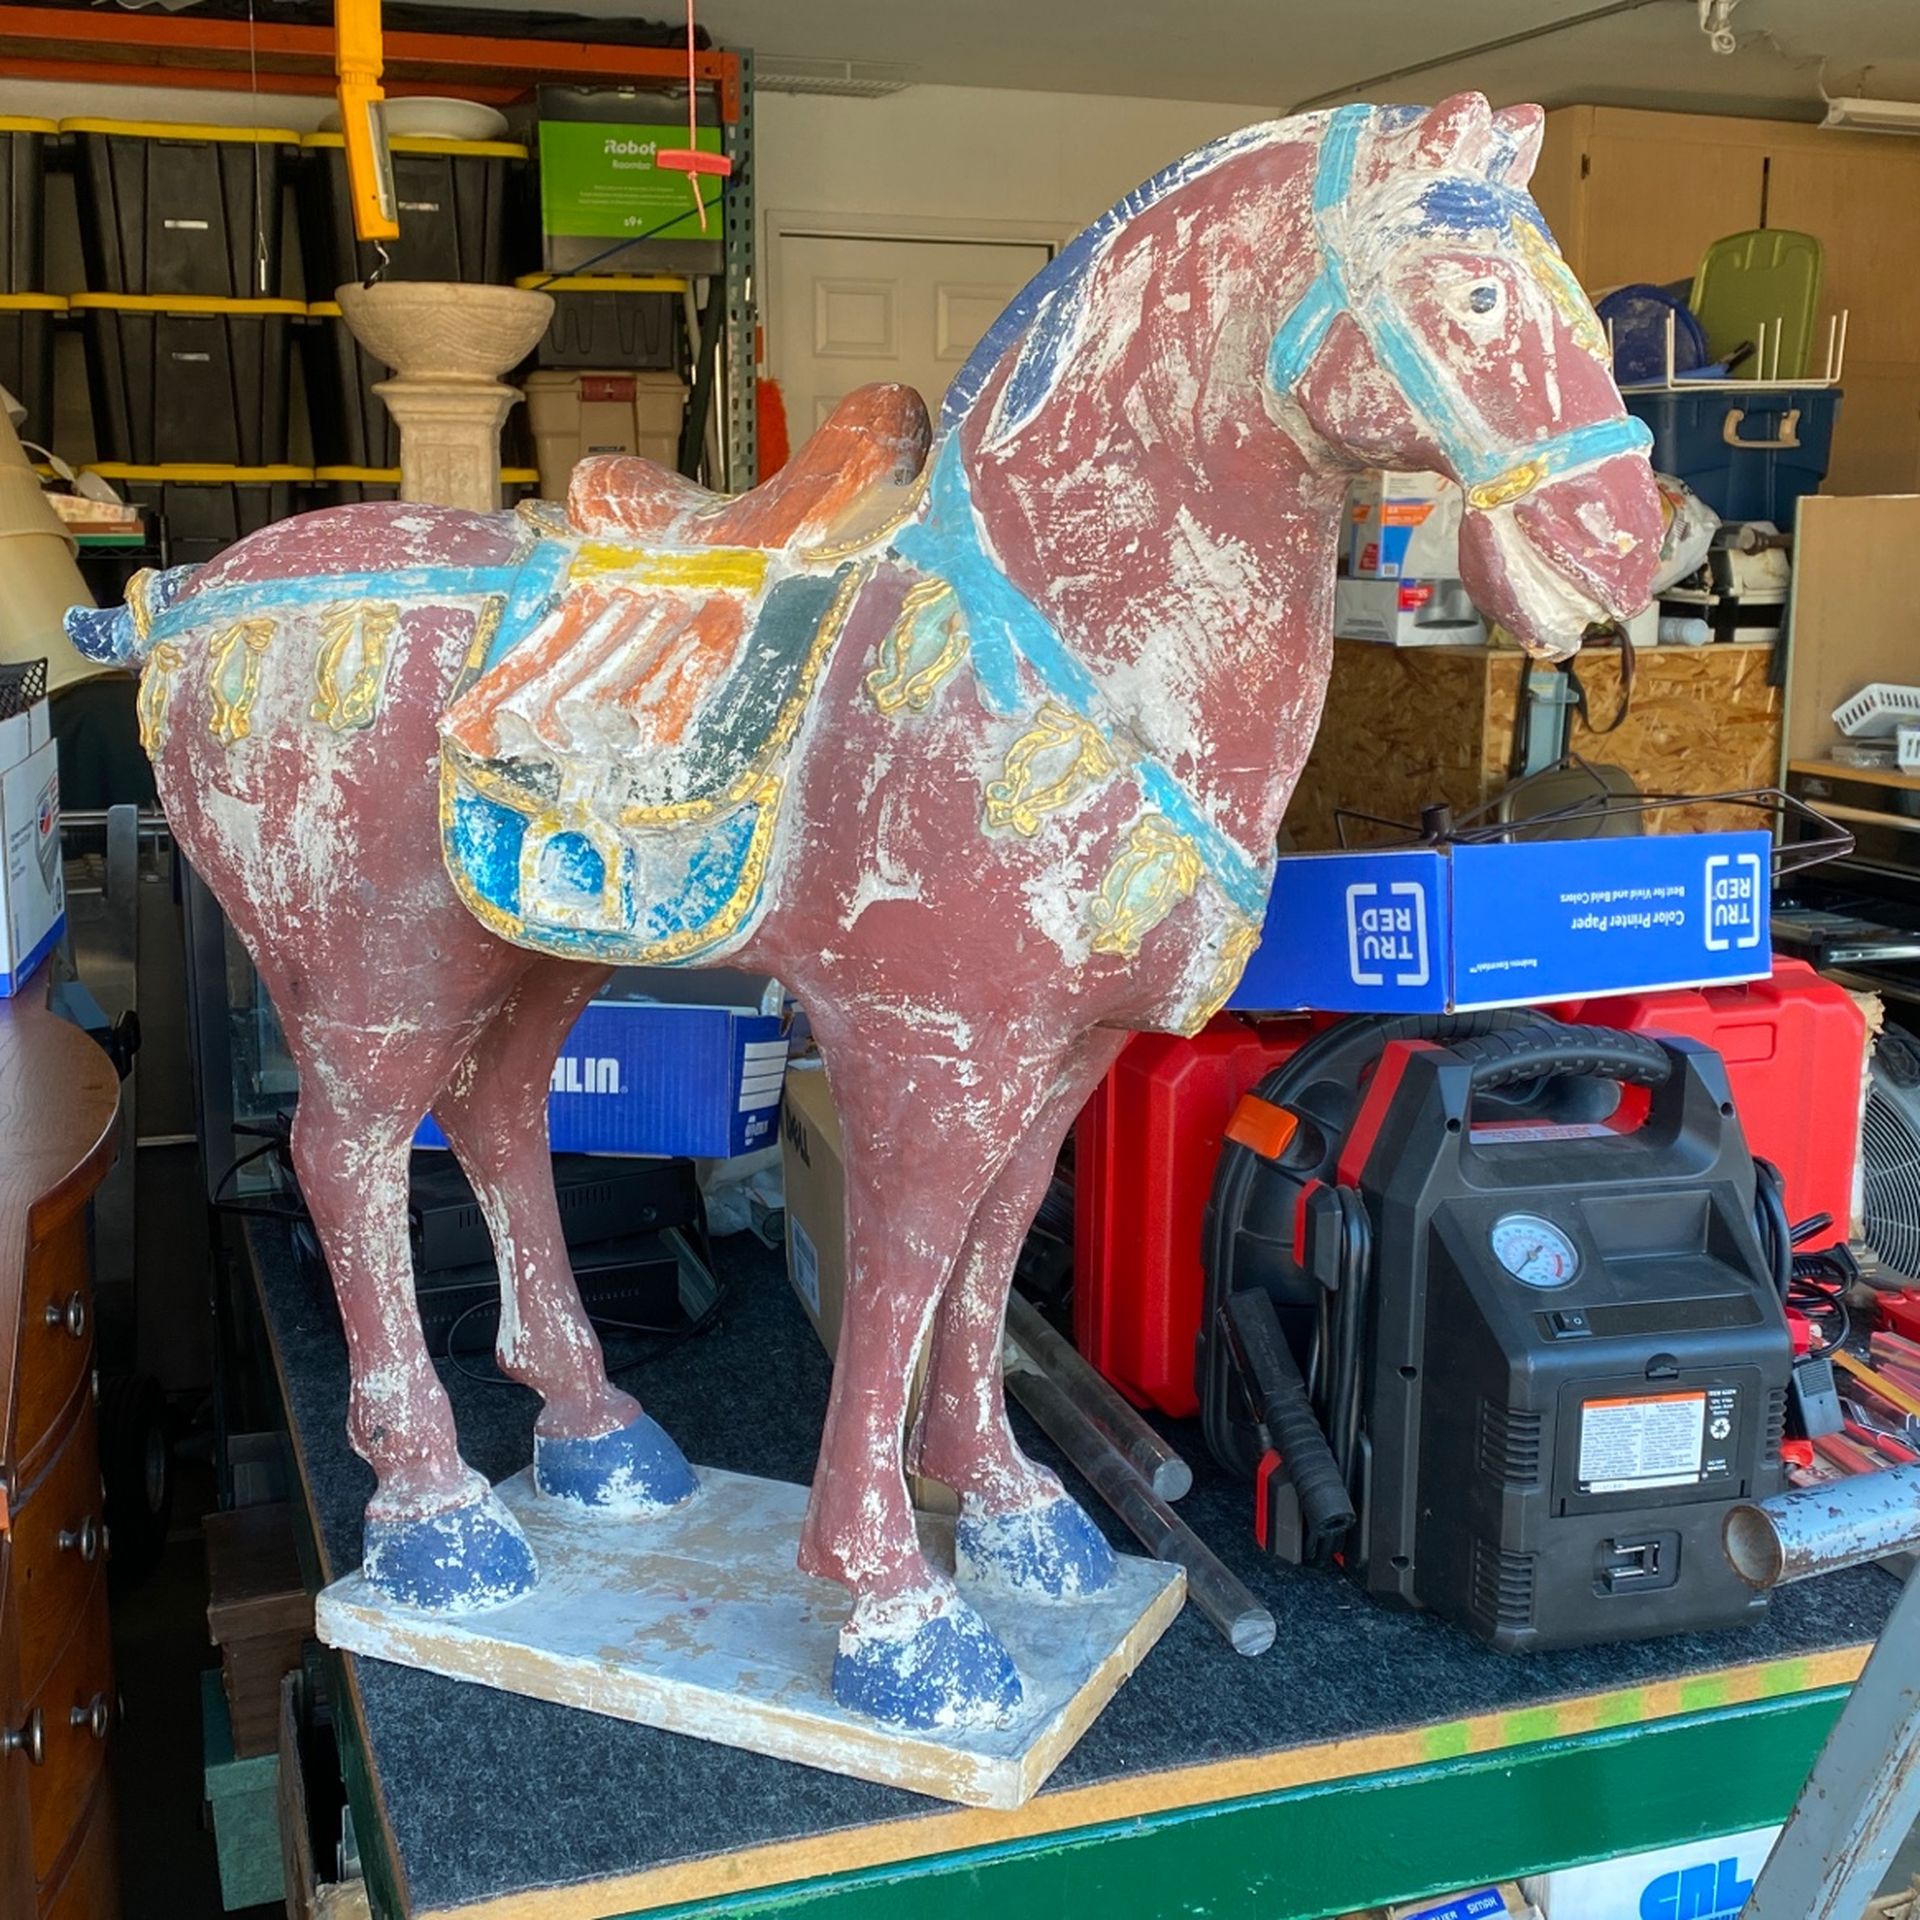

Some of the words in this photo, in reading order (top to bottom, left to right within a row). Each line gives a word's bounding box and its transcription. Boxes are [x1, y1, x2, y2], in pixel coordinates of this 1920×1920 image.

[1590, 890, 1611, 903] Bold
[1612, 889, 1629, 902] and
[1630, 888, 1652, 901] Vivid
[1653, 887, 1666, 899] for
[1666, 885, 1685, 897] Best
[1715, 877, 1751, 900] RED
[1560, 892, 1590, 904] Colors
[1361, 908, 1412, 932] RED
[1571, 912, 1608, 932] Paper
[1609, 912, 1651, 929] Printer
[1652, 909, 1685, 926] Color
[1715, 903, 1751, 926] TRU
[1363, 935, 1414, 960] TRU
